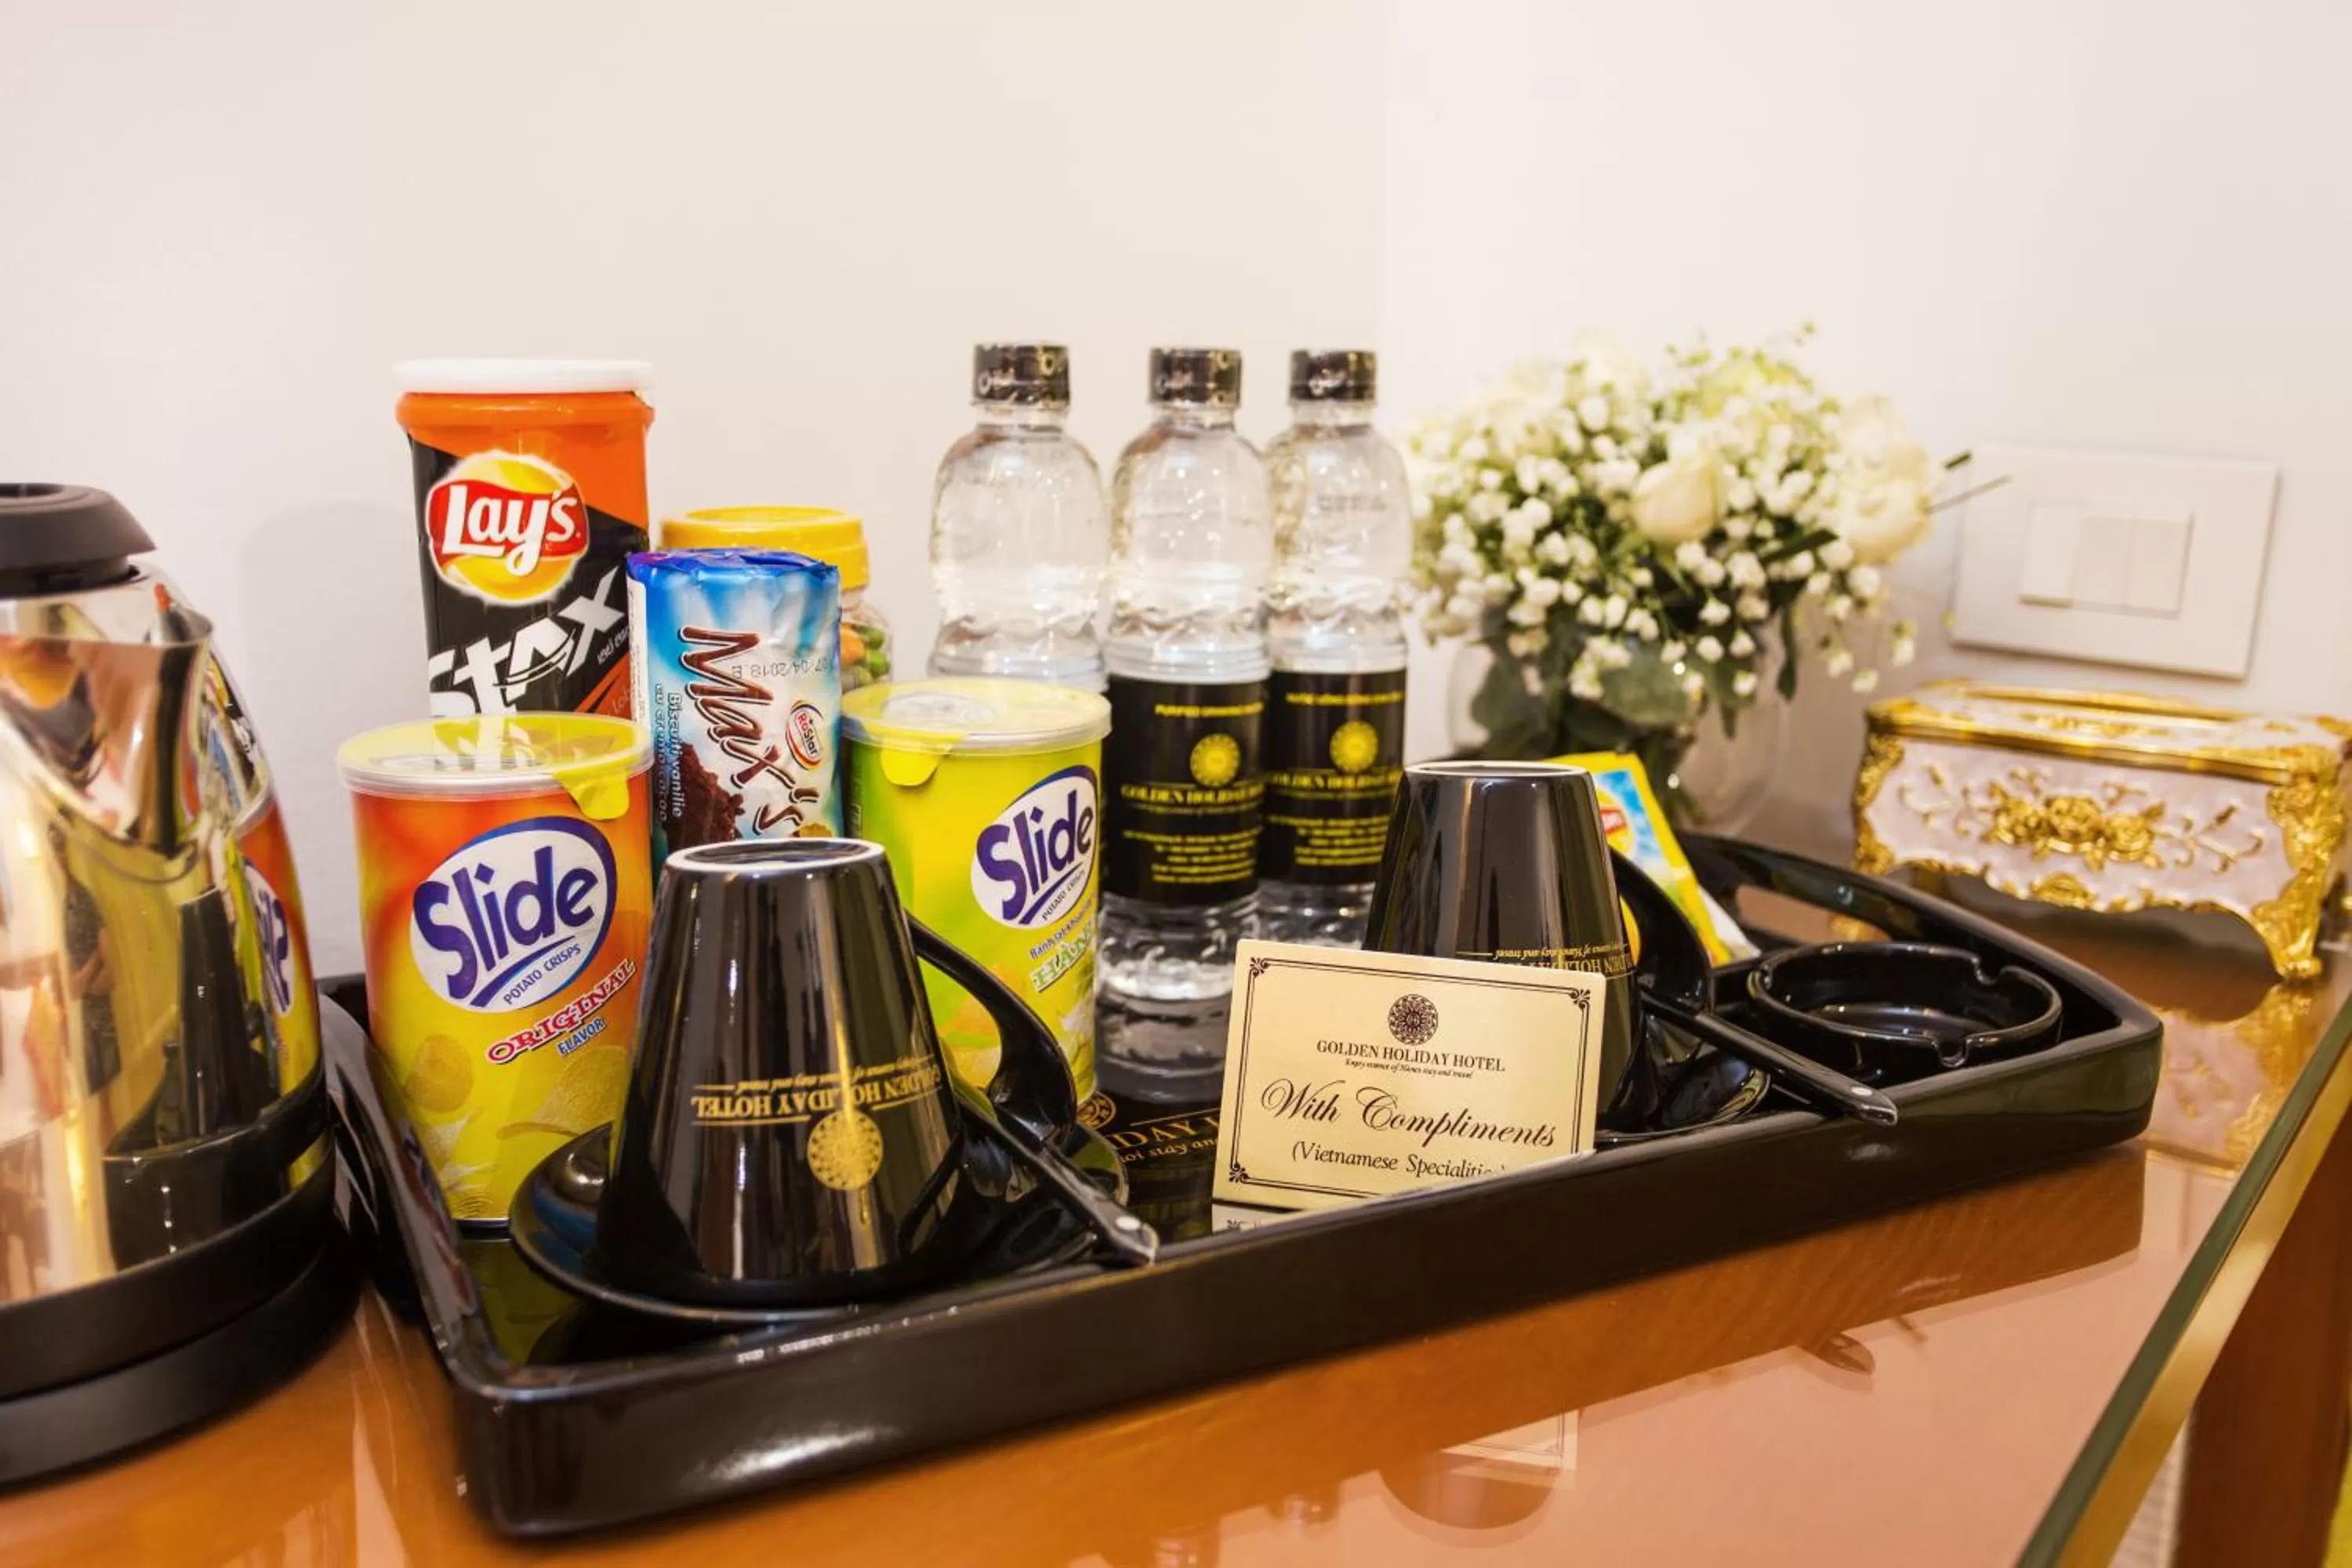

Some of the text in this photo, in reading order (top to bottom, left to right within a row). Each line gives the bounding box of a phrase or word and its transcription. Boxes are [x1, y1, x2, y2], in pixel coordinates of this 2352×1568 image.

[441, 484, 579, 576] Lay's
[678, 626, 820, 835] Max's
[796, 713, 818, 756] RoStar
[670, 758, 686, 818] vanilie
[975, 789, 1094, 921] Slide
[412, 846, 598, 1000] Slide
[503, 943, 583, 1006] POTATO CRISPS
[485, 957, 637, 1064] ORIGINAL
[557, 1018, 605, 1058] FLAVOR
[1316, 1039, 1506, 1073] GOLDEN HOLIDAY HOTEL
[1437, 1068, 1451, 1076] and
[1453, 1069, 1474, 1080] travel
[690, 1095, 771, 1118] HOTEL
[1260, 1078, 1556, 1149] With Compliments
[1148, 1142, 1188, 1156] stay
[1192, 1137, 1218, 1149] an
[1291, 1141, 1506, 1178] (Vietnamese Specialiti
